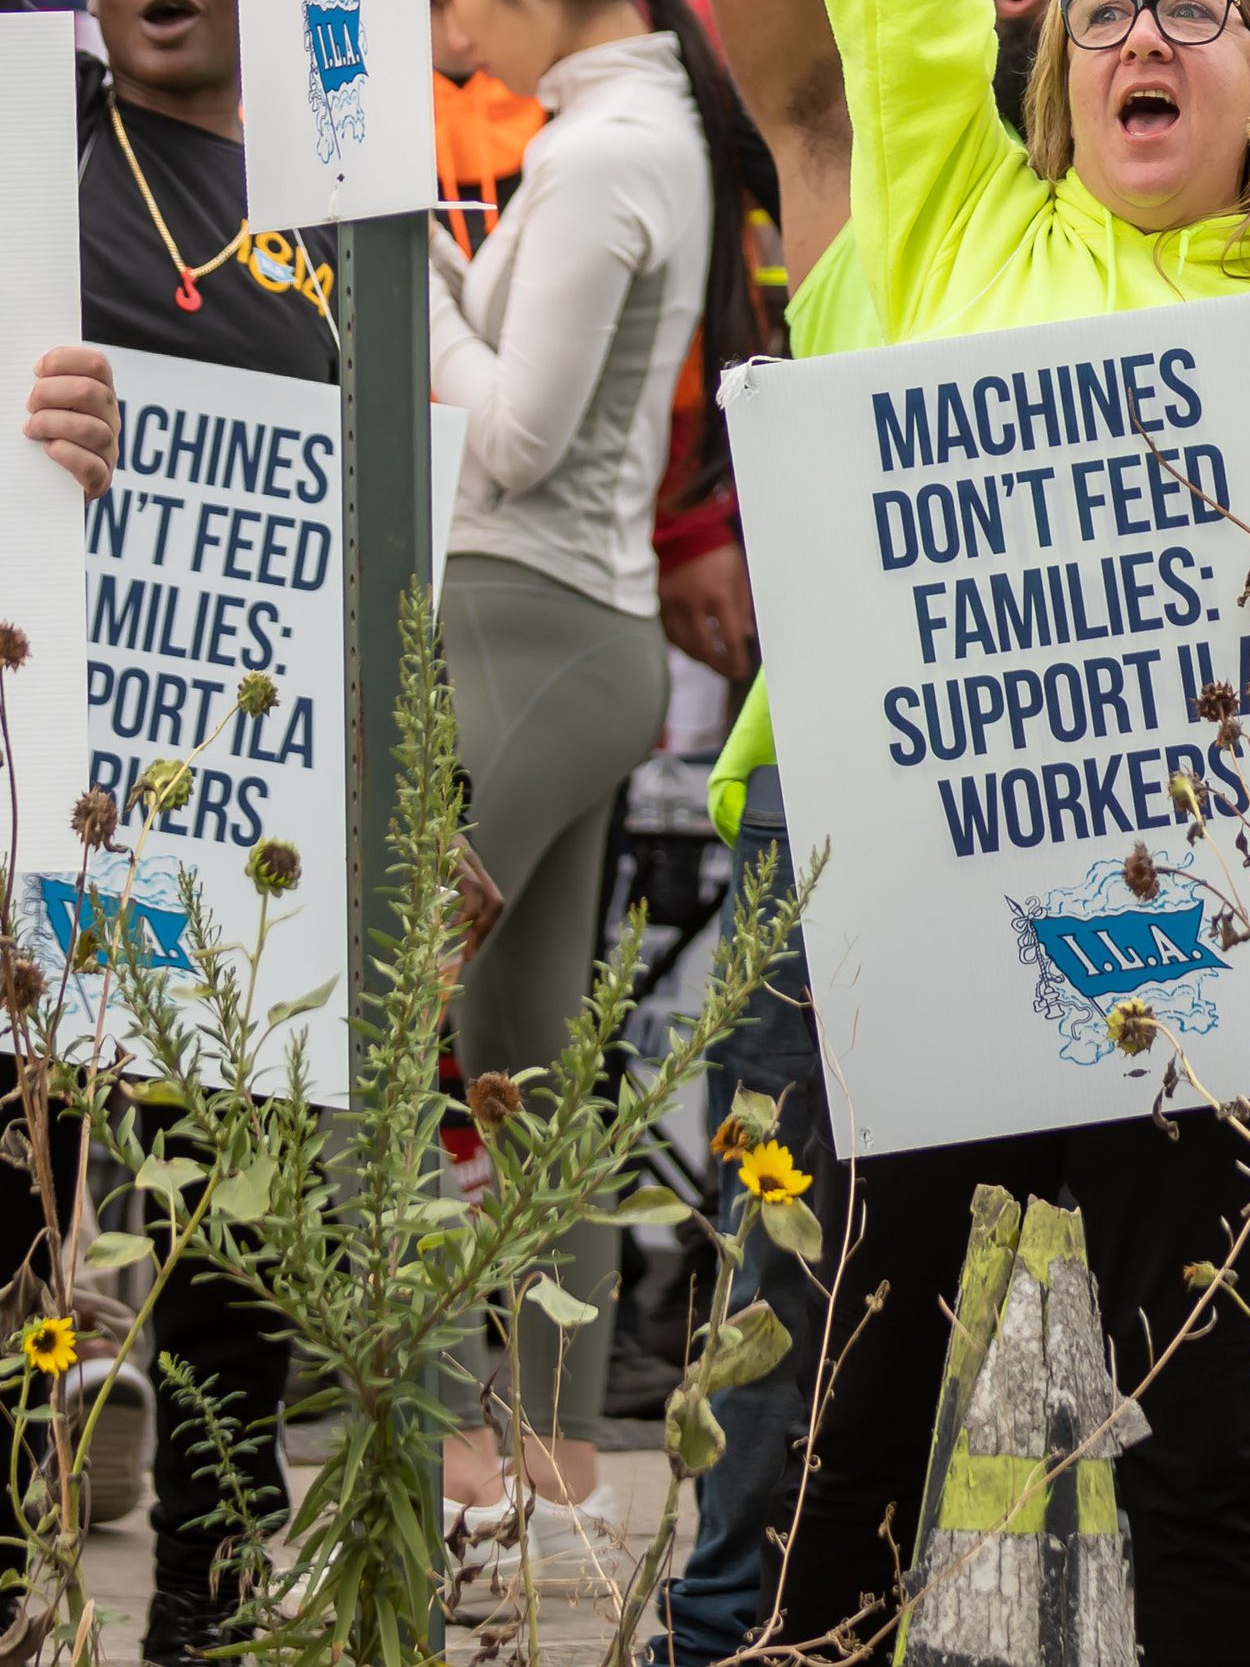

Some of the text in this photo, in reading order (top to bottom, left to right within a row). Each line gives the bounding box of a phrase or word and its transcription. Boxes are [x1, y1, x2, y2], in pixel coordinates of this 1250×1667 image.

[315, 21, 361, 71] I.L.A.
[116, 399, 334, 504] CHINES
[871, 348, 1202, 473] MACHINES
[85, 488, 332, 592] N'T FEED
[872, 443, 1230, 571] DON'T FEED
[85, 571, 293, 677] MILIES:
[912, 546, 1221, 664] FAMILIES:
[87, 660, 225, 747] PORT
[883, 648, 1162, 767] SUPPORT
[1061, 922, 1202, 976] I.L.A.
